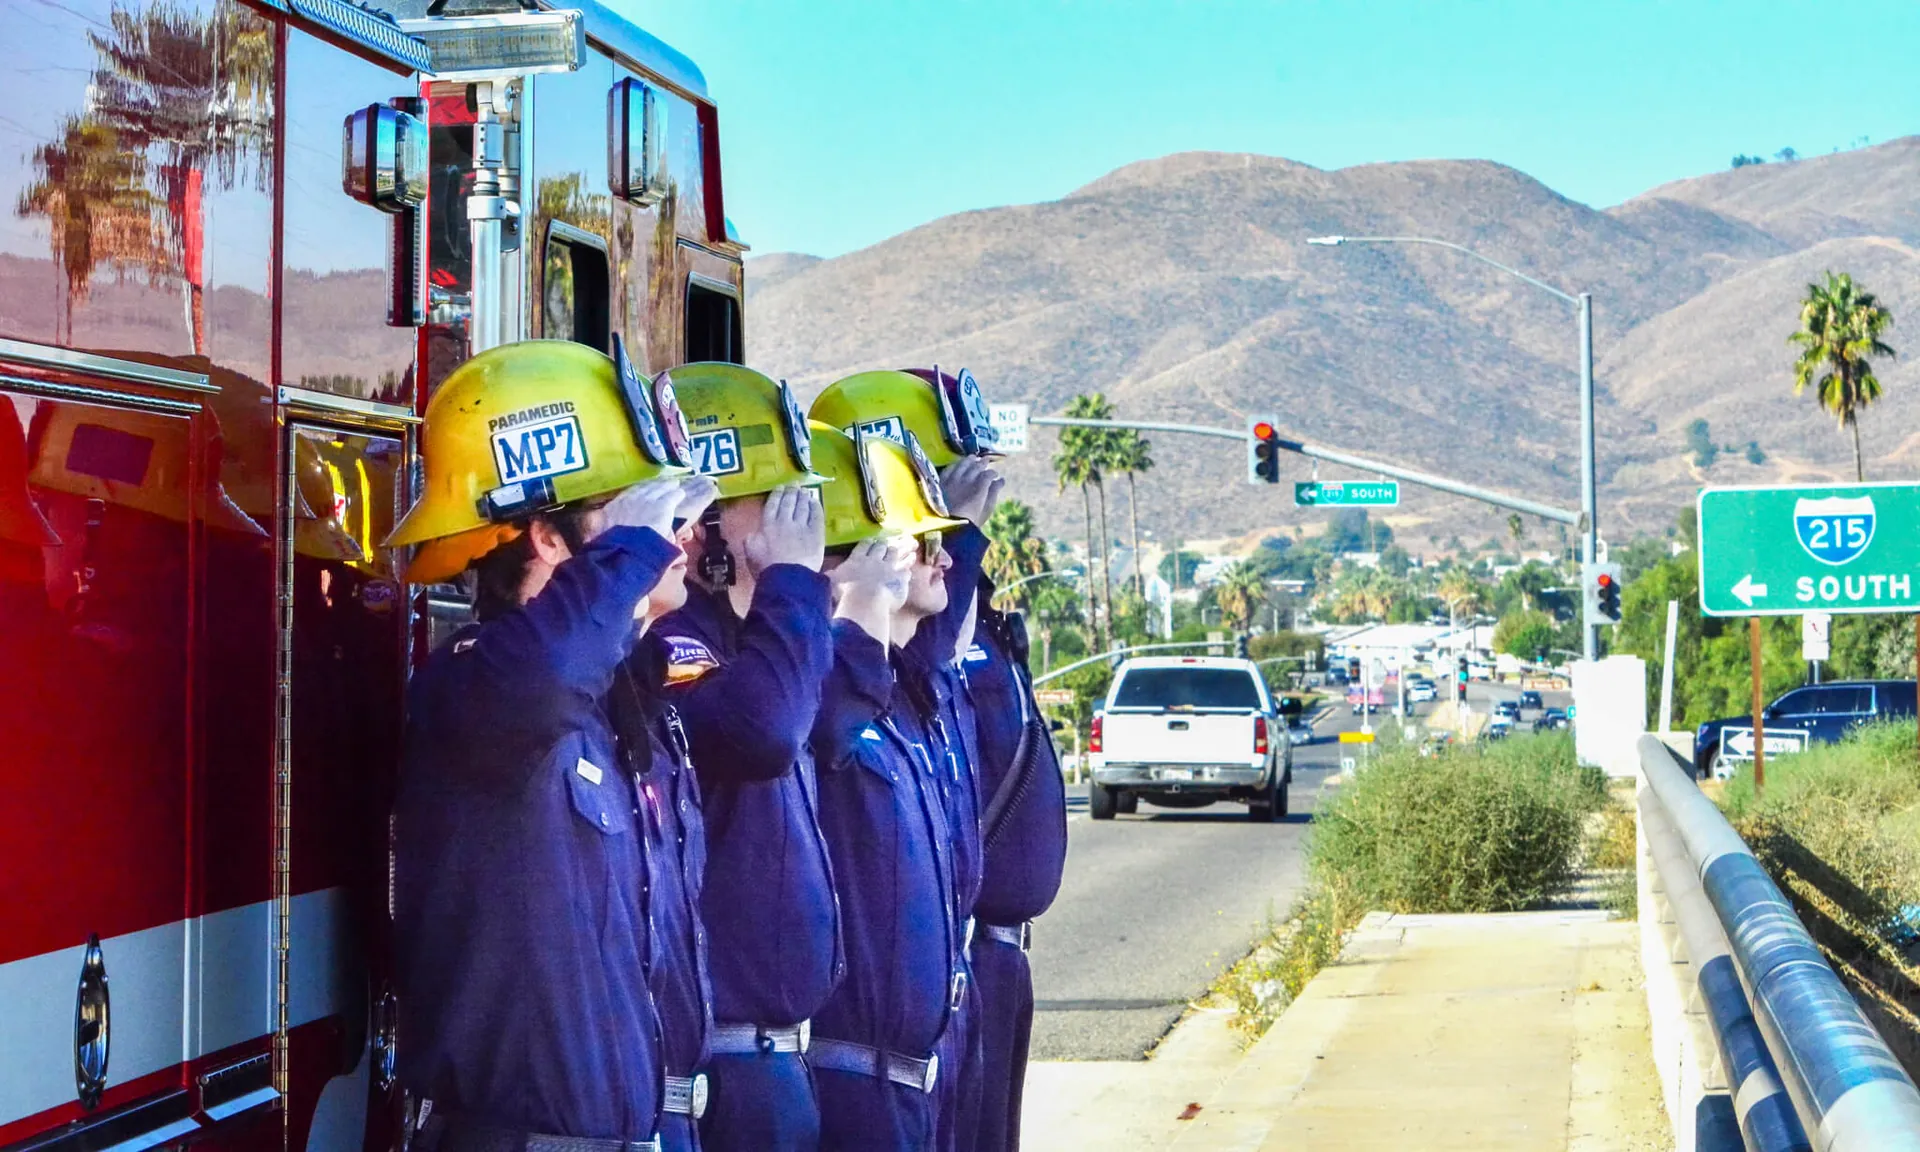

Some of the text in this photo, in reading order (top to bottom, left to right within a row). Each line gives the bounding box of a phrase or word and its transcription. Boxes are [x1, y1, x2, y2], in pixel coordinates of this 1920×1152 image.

[488, 401, 575, 432] PARAMEDIC
[998, 410, 1017, 421] NO
[498, 422, 576, 479] MP7
[689, 433, 736, 473] 76
[1000, 439, 1023, 448] URN
[1351, 488, 1393, 499] SOUTH
[1809, 518, 1867, 549] 215
[1795, 573, 1912, 602] SOUTH
